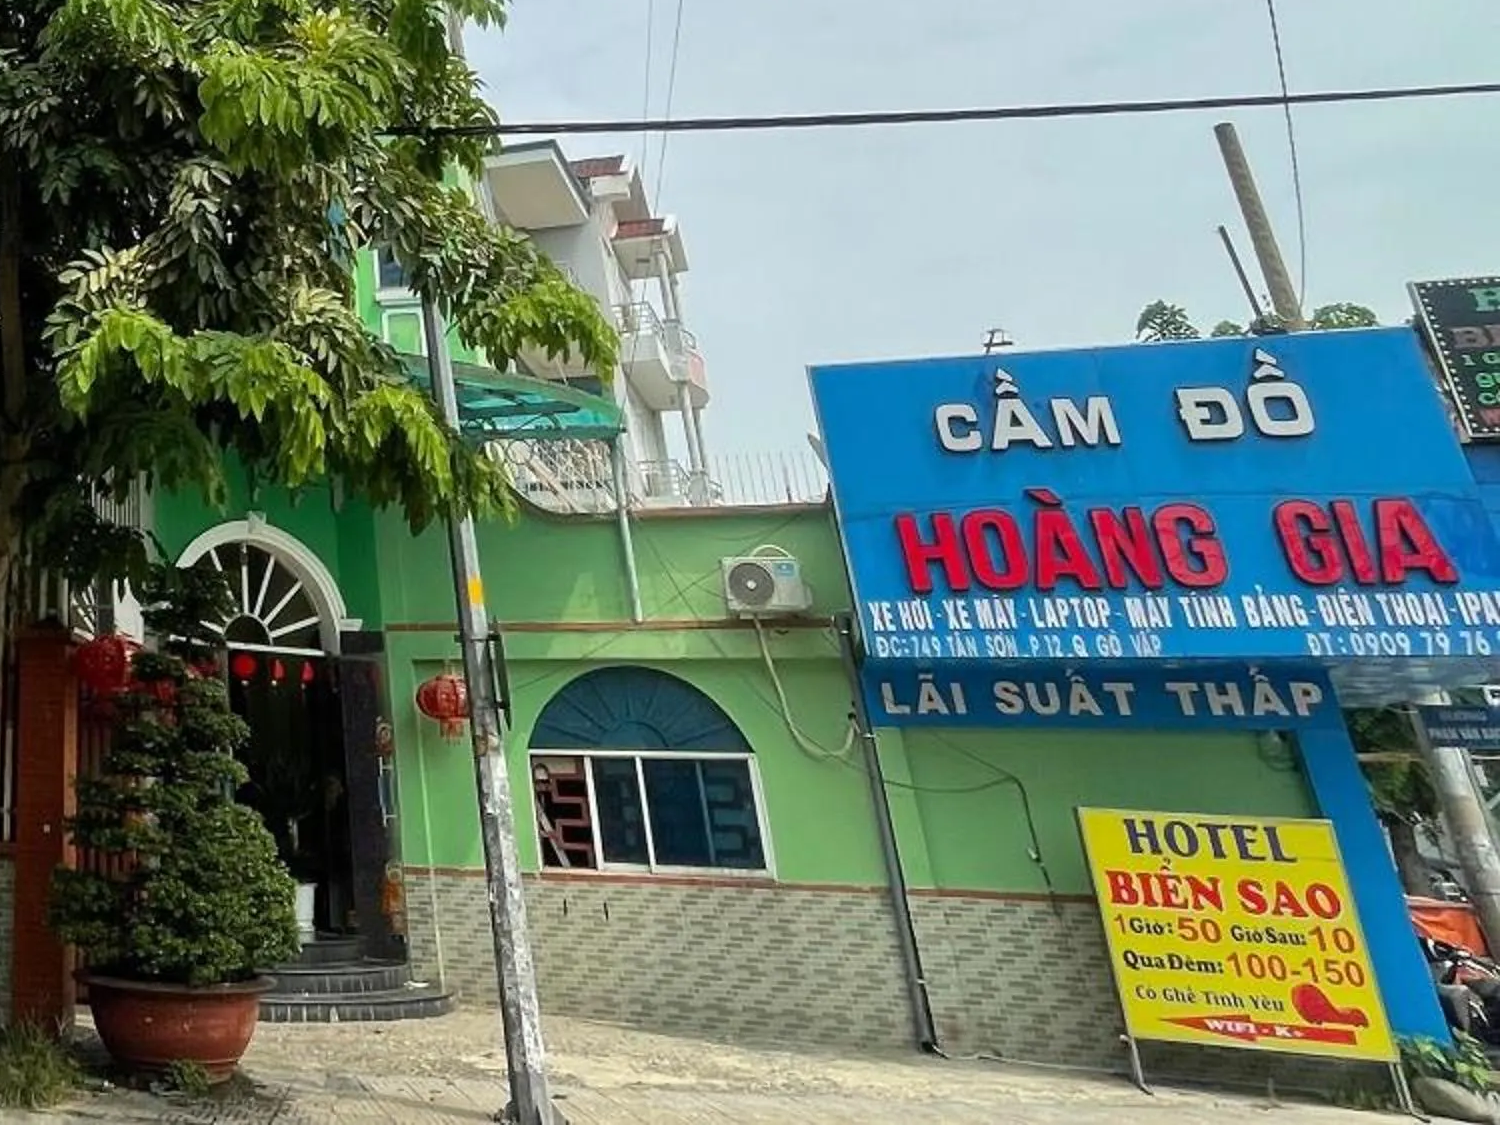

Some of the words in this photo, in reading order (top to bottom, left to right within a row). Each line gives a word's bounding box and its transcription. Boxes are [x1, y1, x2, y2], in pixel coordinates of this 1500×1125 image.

[934, 367, 1121, 452] CẦM
[1175, 347, 1315, 441] ĐỒ
[896, 488, 1230, 592] HOÀNG
[1273, 496, 1460, 587] GIA
[868, 600, 897, 631] XE
[899, 597, 935, 630] HƠI
[942, 598, 973, 630] XE
[974, 594, 1019, 629] MÁY
[1028, 597, 1111, 629] LAPTOP
[1124, 592, 1173, 629] MÁY
[1179, 591, 1237, 628] TÍNH
[1241, 584, 1309, 628] BẢNG
[1420, 632, 1450, 656] 79
[1460, 631, 1491, 656] 76
[881, 674, 968, 715] LÃI
[993, 668, 1135, 716] SUẤT
[1165, 666, 1323, 716] THẤP
[1123, 818, 1298, 863] HOTEL
[1236, 877, 1342, 920] SAO
[1177, 917, 1222, 943] 50
[1308, 926, 1356, 954] 10
